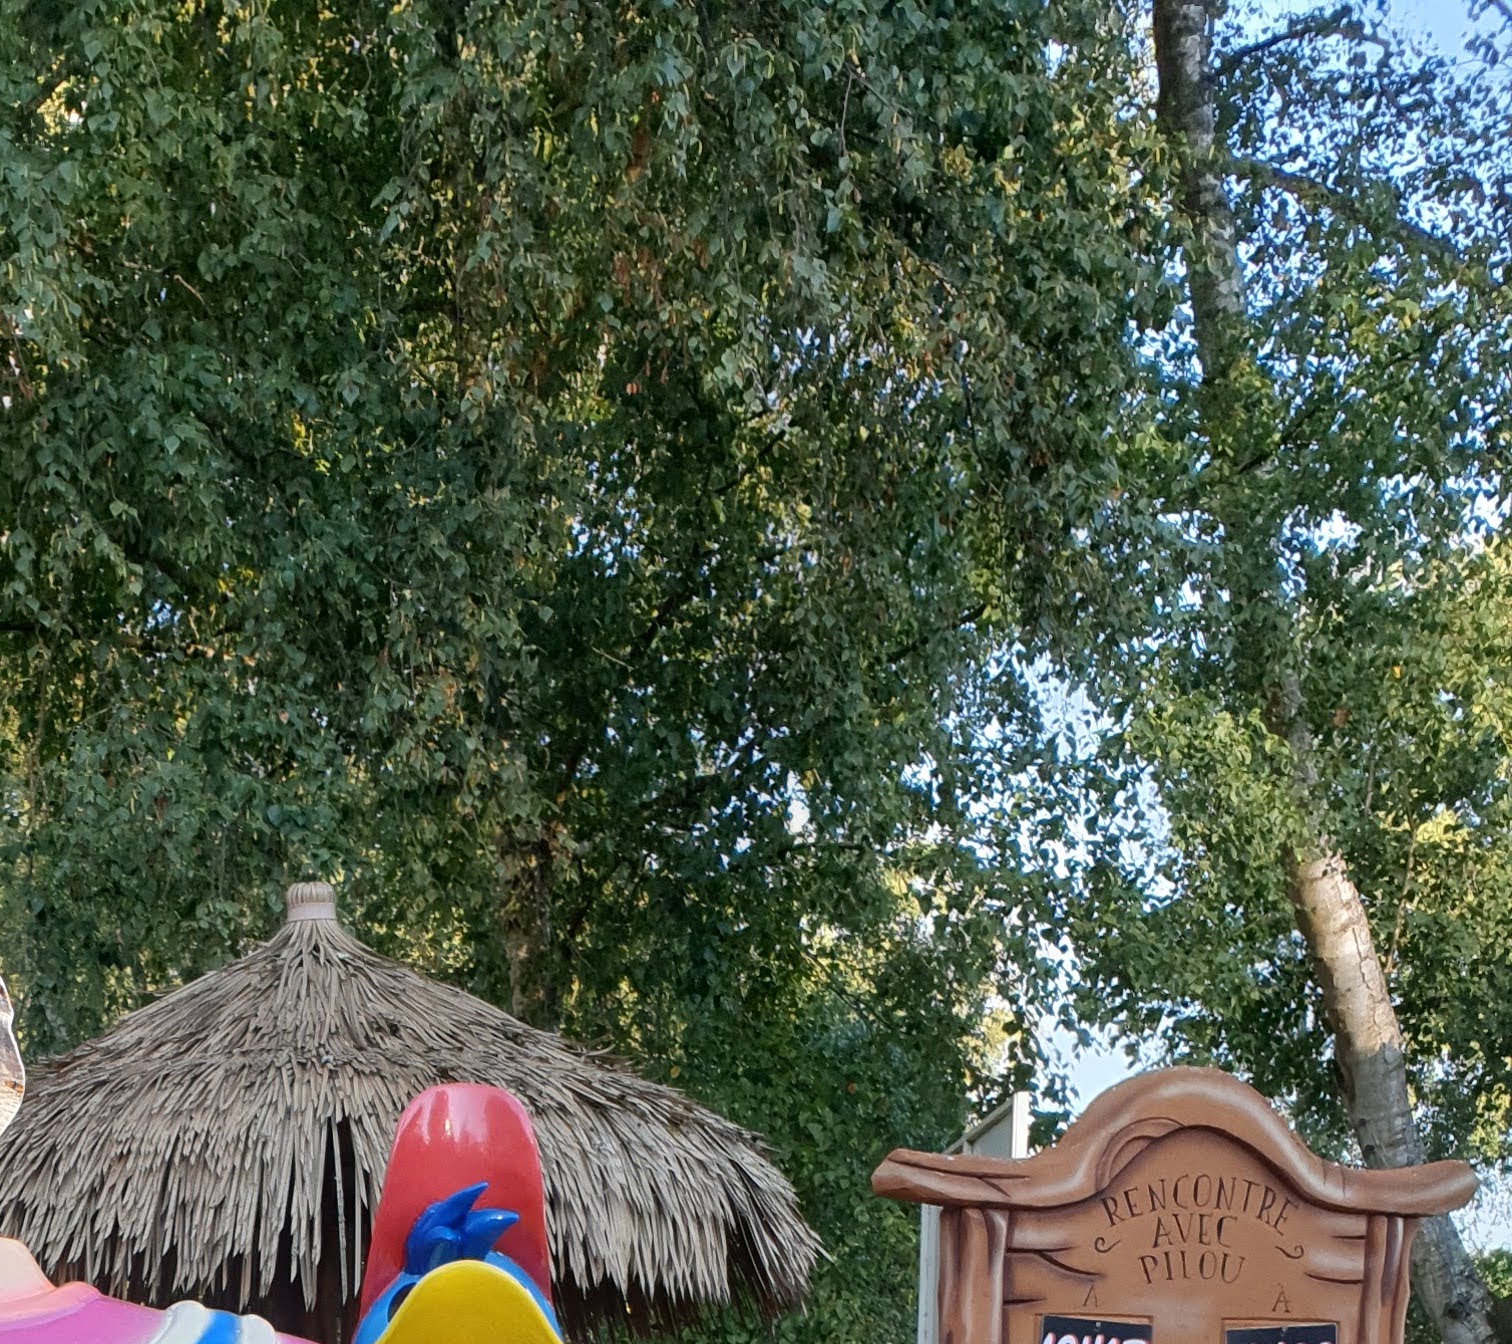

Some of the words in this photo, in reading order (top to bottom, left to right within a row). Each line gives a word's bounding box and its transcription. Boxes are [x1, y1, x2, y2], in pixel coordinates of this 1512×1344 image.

[1099, 1174, 1298, 1236] RENCONTRE
[1152, 1212, 1238, 1249] AVEC
[1137, 1250, 1245, 1284] PILOU
